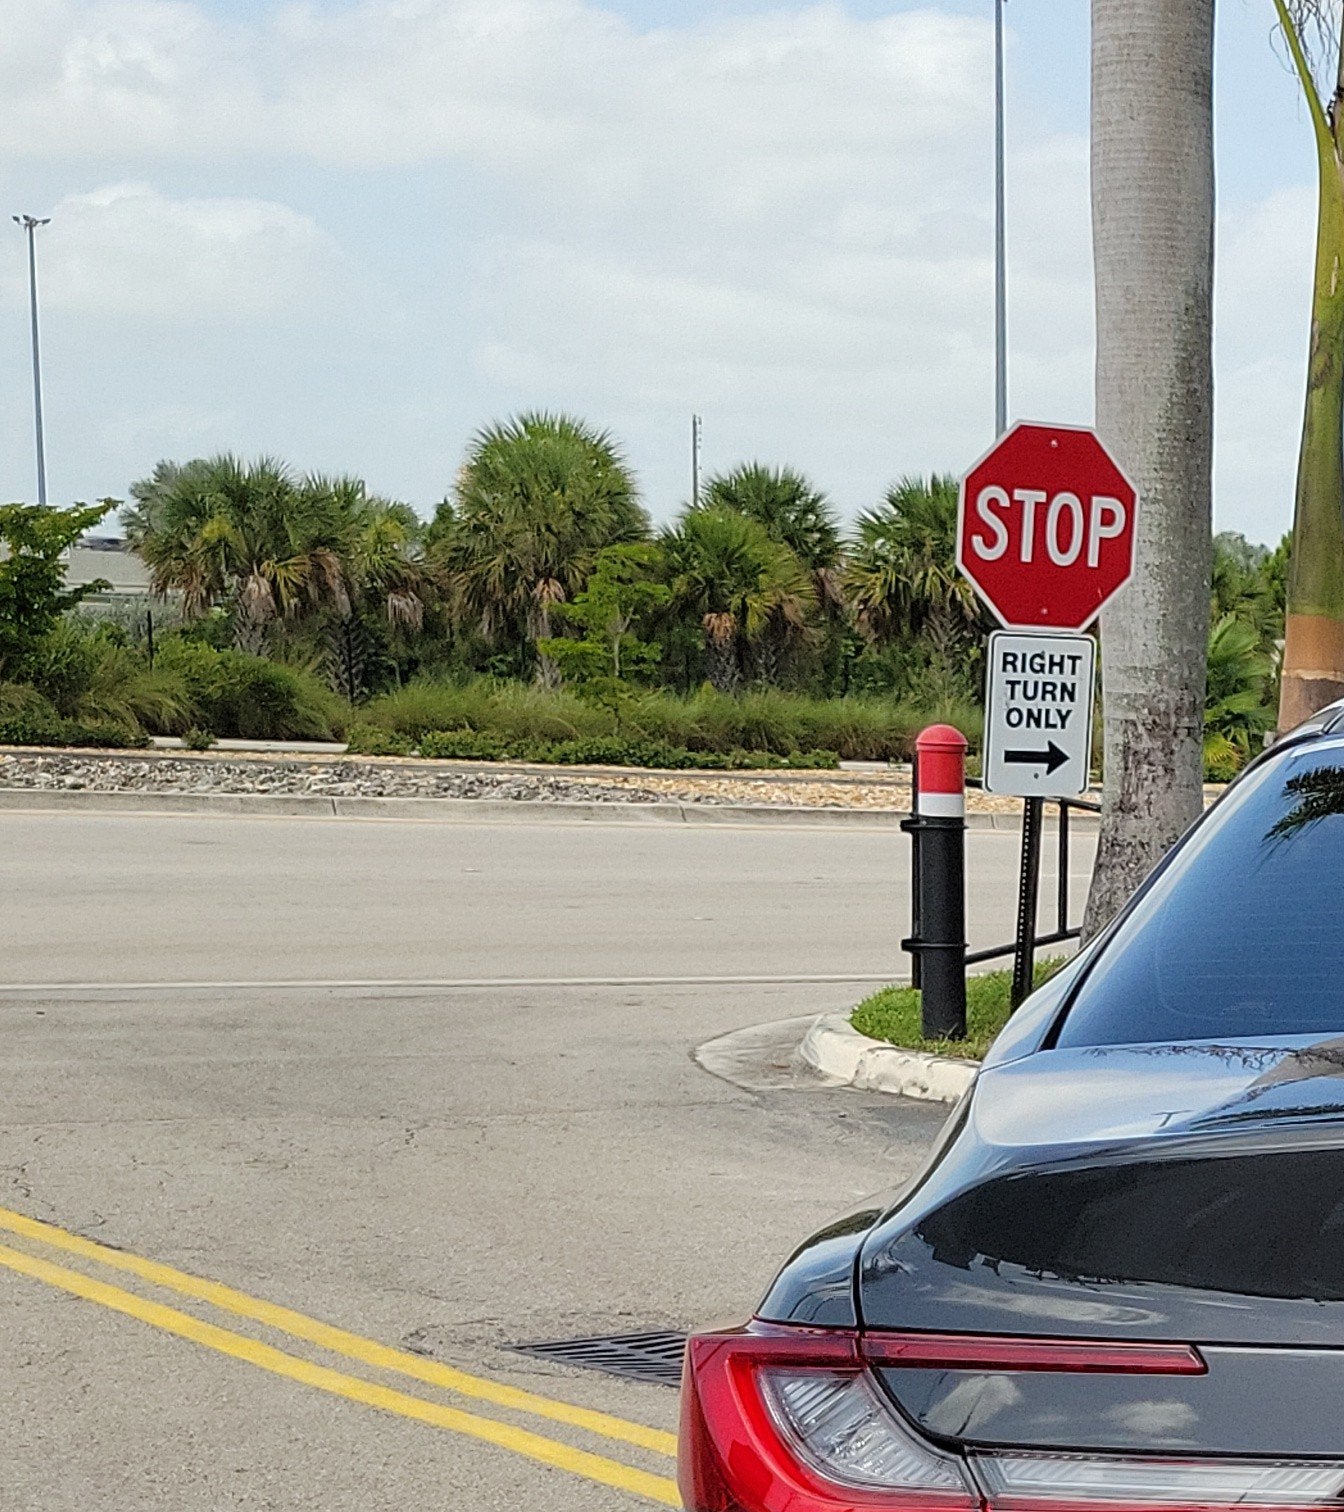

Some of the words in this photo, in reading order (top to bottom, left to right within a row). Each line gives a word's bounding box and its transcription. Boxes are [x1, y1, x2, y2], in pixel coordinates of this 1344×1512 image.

[971, 484, 1127, 568] STOP
[1002, 651, 1082, 676] RIGHT
[1005, 679, 1077, 703] TURN
[1006, 707, 1073, 730] ONLY
